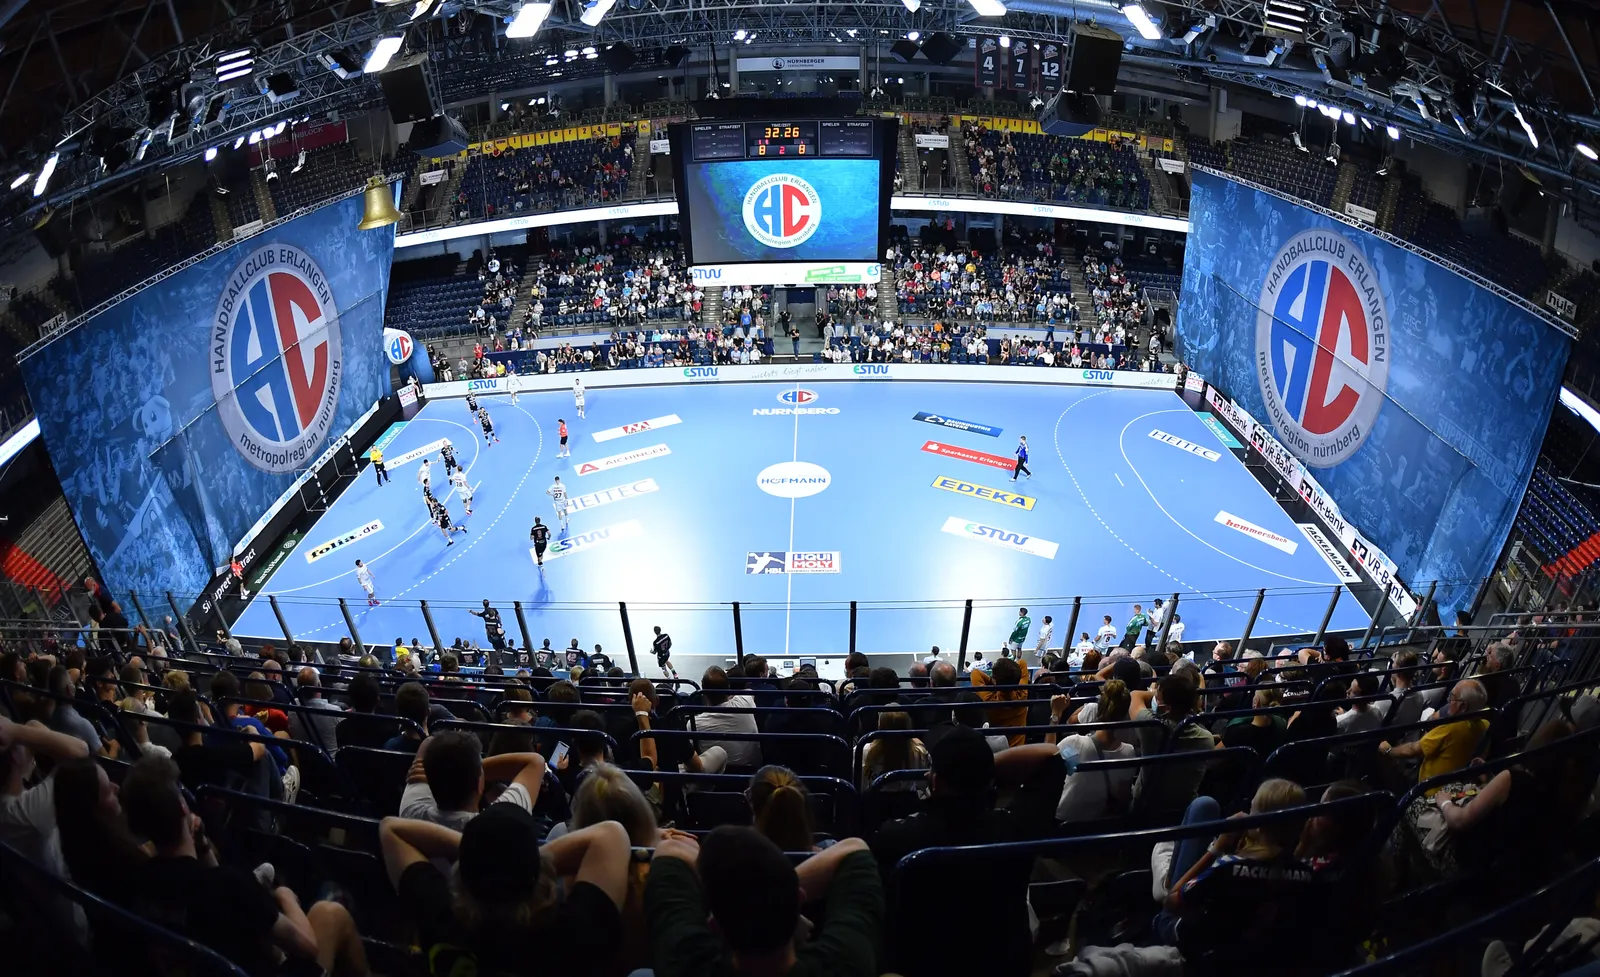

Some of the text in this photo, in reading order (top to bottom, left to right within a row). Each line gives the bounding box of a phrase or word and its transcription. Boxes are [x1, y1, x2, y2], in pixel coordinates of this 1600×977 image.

[983, 56, 994, 70] 4
[1016, 59, 1024, 73] 7
[1041, 62, 1060, 76] 12
[759, 143, 806, 155] 8 2 8
[746, 175, 818, 205] HANDBALLCLUB ERLANGEN
[749, 223, 791, 245] metropolregion
[215, 249, 330, 373] HANDBALLCLUB ERLANGEN
[1267, 236, 1385, 363] HANDBALLCLUB ERLANGEN
[240, 360, 341, 468] metropolregion nürnberg
[1222, 401, 1248, 432] VR-Bank
[1259, 351, 1361, 459] metropolregion nürnberg
[944, 422, 969, 430] BAYERN
[946, 418, 992, 432] BAUINDUSTRIE
[605, 447, 667, 466] AICHINGER
[940, 447, 1013, 468] Sparkasse Erlangen
[1152, 430, 1215, 460] HEITEC
[1264, 439, 1295, 478] VR-Bank
[566, 480, 651, 510] HEITEC
[761, 476, 827, 485] HOFMANN
[939, 479, 1027, 508] EDEKA
[1313, 491, 1345, 535] VR-Bank
[311, 524, 379, 559] folia.de
[1224, 518, 1288, 544] hemmersbach
[793, 560, 832, 568] MOLY
[1306, 526, 1353, 578] FACKELMANN
[254, 550, 285, 584] BarthHaas
